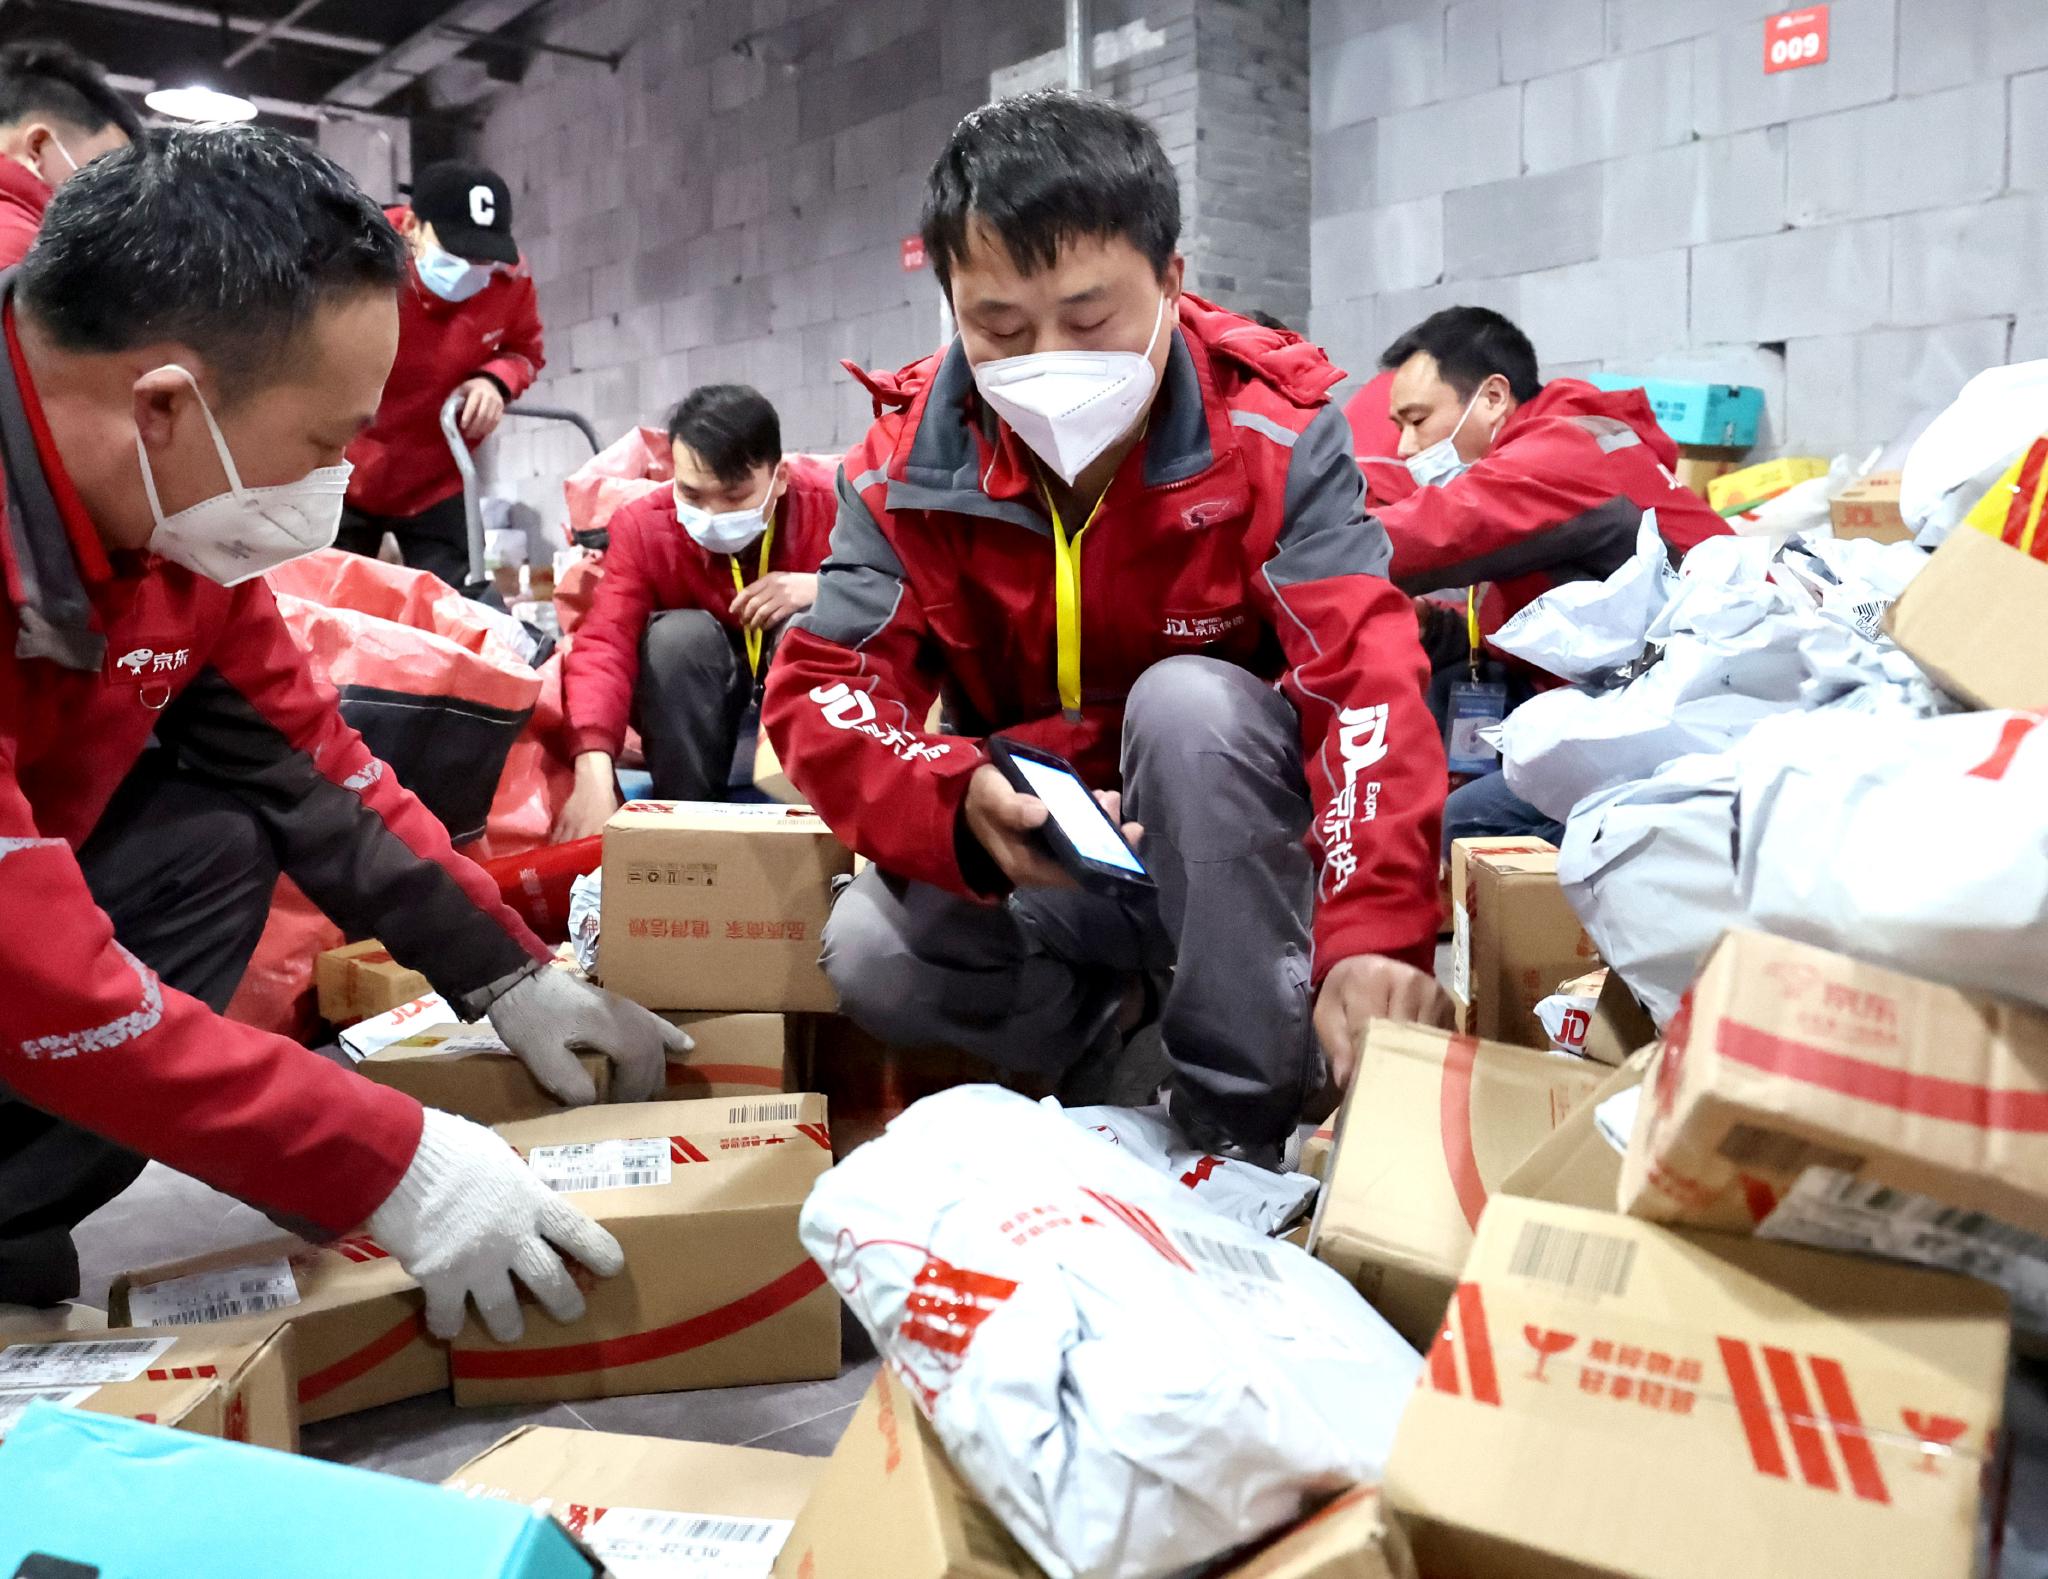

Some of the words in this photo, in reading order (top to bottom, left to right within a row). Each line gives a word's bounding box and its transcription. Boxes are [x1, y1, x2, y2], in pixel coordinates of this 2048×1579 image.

[1770, 32, 1820, 64] 009
[468, 185, 496, 226] C
[1162, 618, 1195, 636] JDL
[152, 648, 190, 673] 京东
